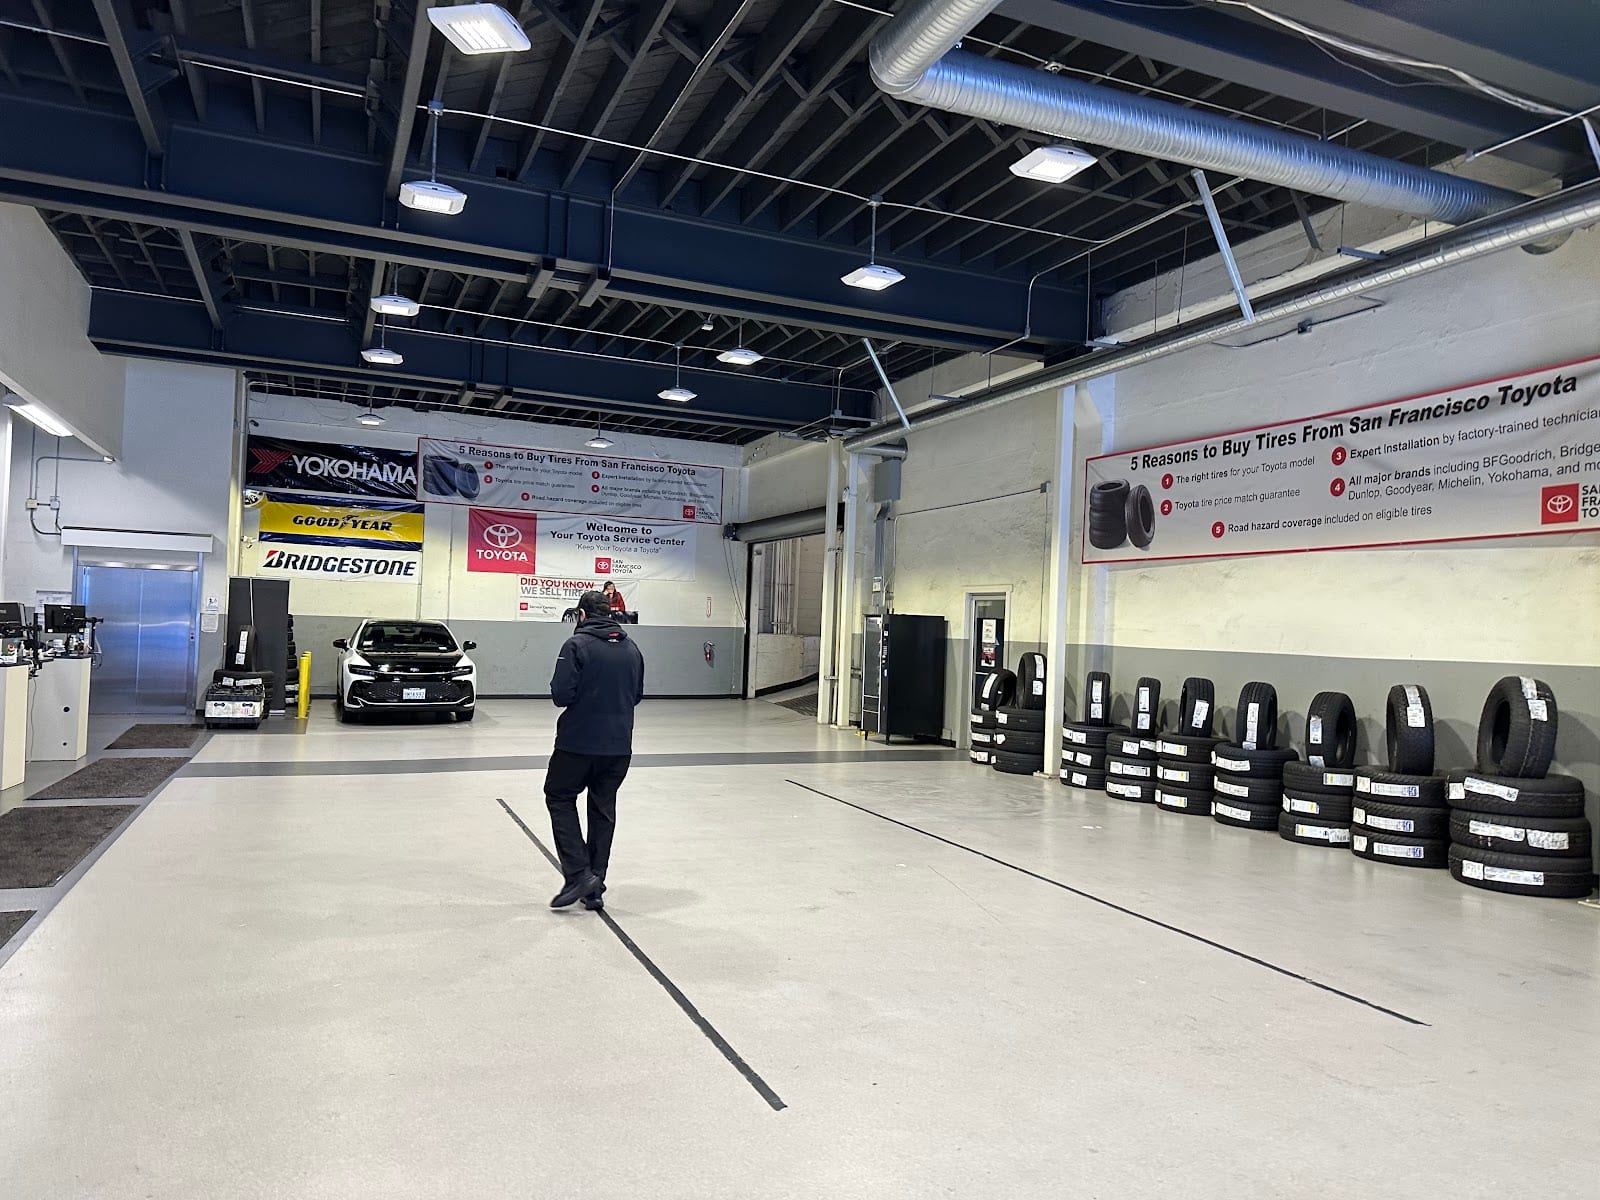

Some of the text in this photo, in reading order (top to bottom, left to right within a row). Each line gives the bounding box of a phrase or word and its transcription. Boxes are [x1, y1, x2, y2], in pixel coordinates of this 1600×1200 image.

[1130, 375, 1578, 471] 5 Reasons to Buy Tires From San Francisco Toyota
[1350, 446, 1382, 462] Expert
[1383, 436, 1440, 454] Installation
[1442, 433, 1455, 445] by
[1458, 419, 1539, 440] factory-trained
[1543, 409, 1600, 427] technicia
[292, 454, 417, 485] YOKOHAMA
[459, 446, 696, 477] 5 Reasons to Buy Tires From San Francisco Toyota
[1176, 475, 1190, 485] The
[1190, 471, 1210, 487] right
[1211, 469, 1228, 480] tires
[1230, 467, 1241, 477] for
[1241, 466, 1260, 479] your
[1260, 461, 1288, 475] Toyota
[1289, 456, 1316, 468] model
[1349, 476, 1362, 487] All
[1364, 472, 1392, 487] major
[1394, 467, 1431, 480] brands
[1433, 459, 1480, 475] including
[1482, 449, 1556, 469] BFGoodrich,
[1348, 488, 1382, 501] Dunlop,
[1385, 482, 1435, 496] Goodyear,
[1438, 476, 1485, 490] Michelin,
[1487, 466, 1553, 485] Yokohama,
[1556, 461, 1580, 475] and
[1582, 485, 1600, 495] SA
[1175, 500, 1200, 512] Toyota
[1201, 498, 1213, 508] tire
[1214, 496, 1233, 510] price
[1234, 493, 1258, 504] match
[1259, 489, 1301, 503] guarantee
[586, 522, 653, 534] Welcome to
[1228, 523, 1249, 533] Road
[1251, 520, 1280, 531] hazard
[1282, 518, 1322, 530] coverage
[1324, 508, 1360, 524] included
[1361, 511, 1374, 522] on
[1375, 506, 1409, 521] eligible
[1411, 505, 1432, 516] tires
[550, 531, 685, 546] Your Toyota Service Center
[575, 543, 594, 551] "Keep
[612, 545, 632, 553] Toyota
[639, 546, 662, 554] Toyota"
[262, 550, 417, 576] BRIDGESTONE
[476, 549, 528, 562] TOYOTA
[520, 578, 538, 586] DID
[540, 579, 560, 587] YOU
[521, 587, 538, 595] WE
[540, 587, 561, 595] SELL
